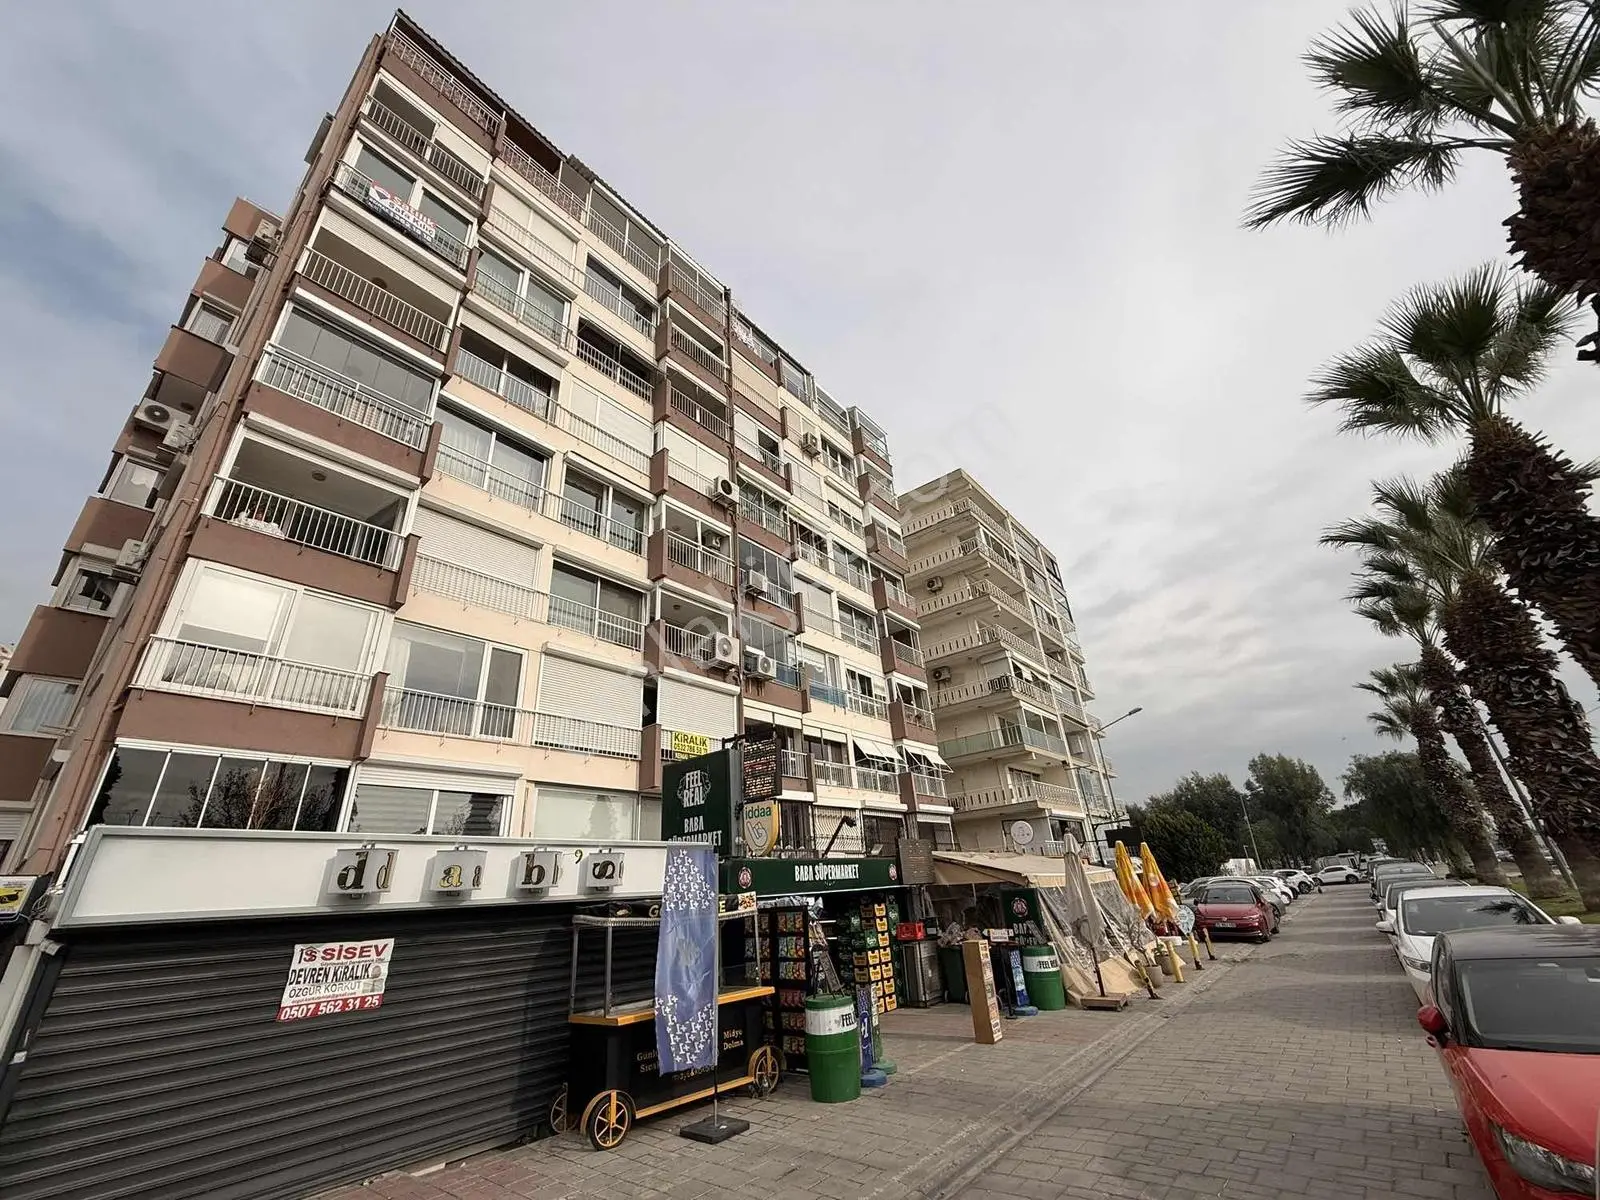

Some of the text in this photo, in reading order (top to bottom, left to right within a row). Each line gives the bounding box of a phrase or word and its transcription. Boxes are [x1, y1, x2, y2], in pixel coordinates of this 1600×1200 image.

[685, 769, 702, 789] FEEL
[683, 786, 706, 808] REAL
[745, 805, 772, 819] iddaa
[684, 815, 704, 833] BABA
[794, 863, 859, 881] BABA SÜPERMARKET
[289, 966, 330, 985] DEVREN
[324, 981, 361, 994] KORKUT
[281, 1003, 316, 1019] 0507
[318, 999, 343, 1015] 562
[345, 997, 360, 1010] 31
[364, 994, 379, 1008] 25
